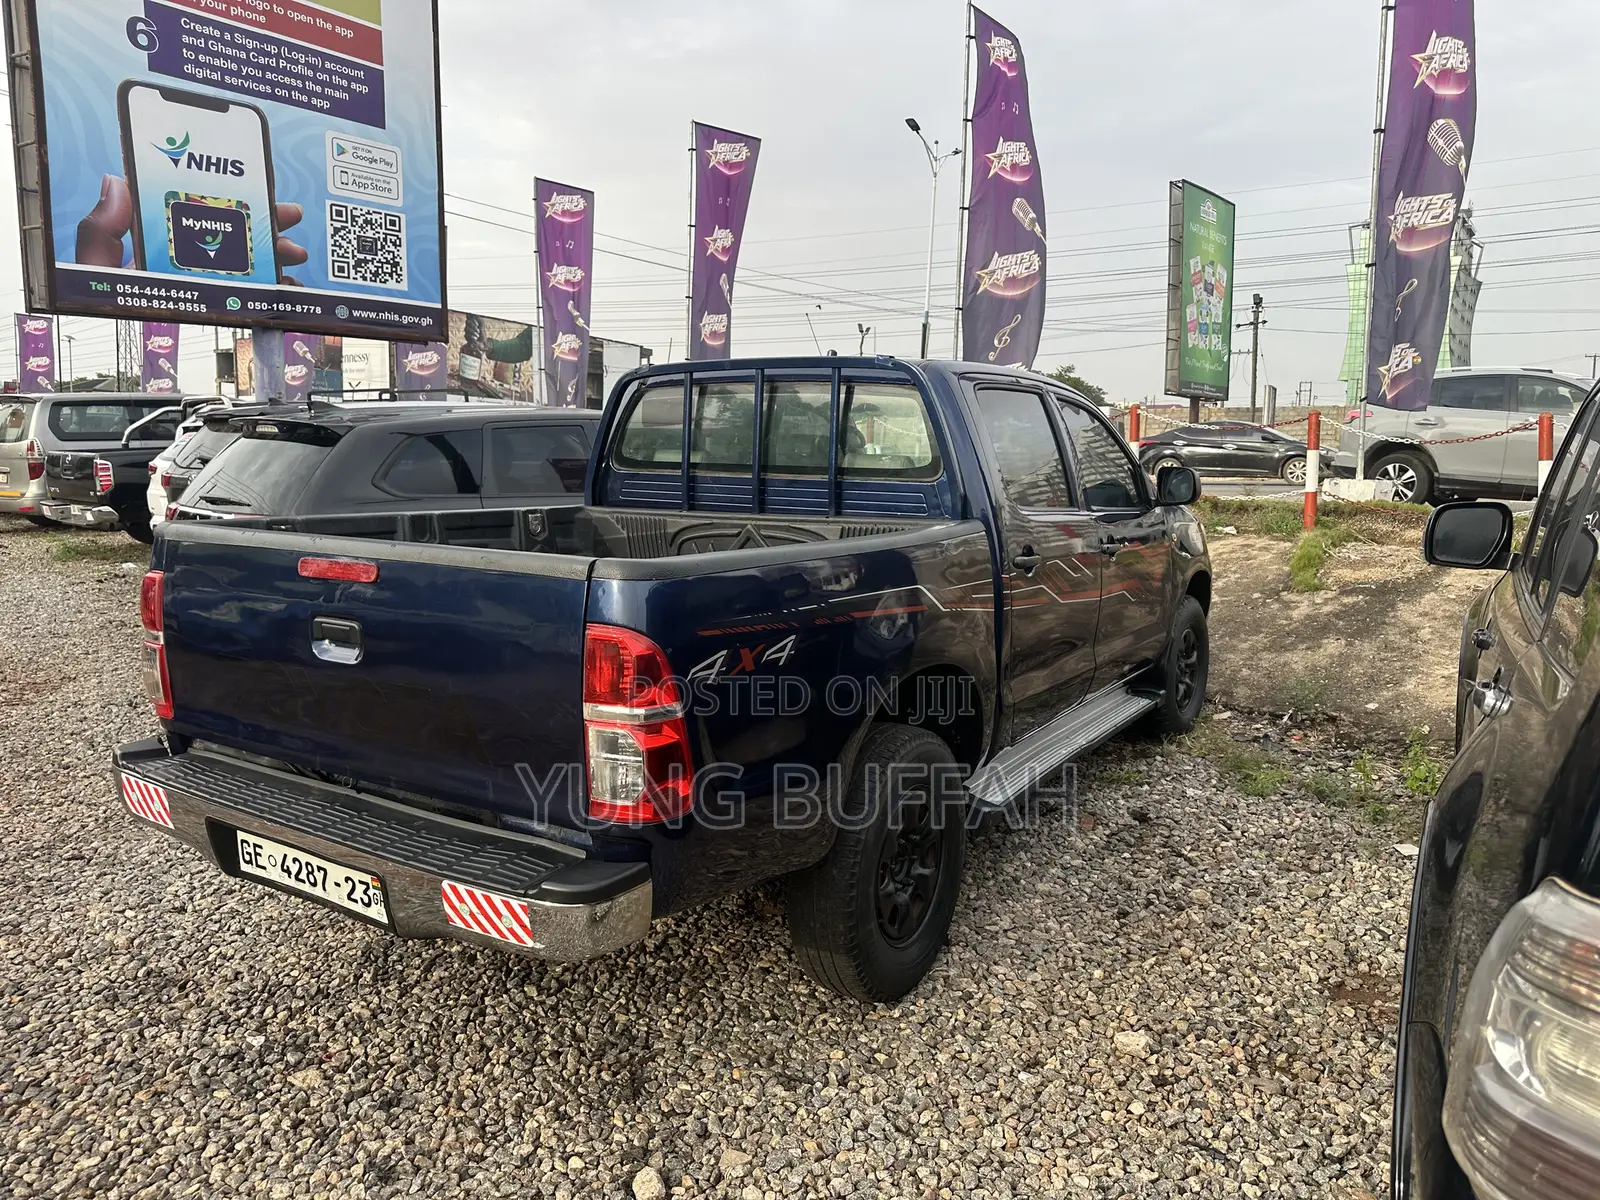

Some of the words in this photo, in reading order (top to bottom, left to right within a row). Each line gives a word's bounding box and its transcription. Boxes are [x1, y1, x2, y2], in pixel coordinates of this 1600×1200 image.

[200, 0, 227, 11] your
[230, 6, 266, 23] phone
[273, 4, 284, 15] to
[288, 10, 313, 25] open
[316, 16, 332, 31] the
[335, 24, 354, 39] app
[126, 15, 158, 53] 6
[180, 17, 222, 38] Create
[224, 31, 231, 40] a
[234, 32, 278, 55] Sign-up
[281, 45, 322, 68] (Log-in)
[325, 59, 365, 79] account
[181, 33, 205, 48] and
[208, 40, 246, 60] Ghana
[250, 51, 276, 67] Card
[280, 59, 313, 78] Profile
[316, 71, 330, 82] on
[332, 73, 348, 87] the
[350, 80, 369, 94] app
[182, 48, 196, 59] to
[198, 51, 238, 72] enable
[240, 64, 262, 78] you
[265, 70, 303, 88] access
[305, 79, 322, 94] the
[325, 85, 349, 101] main
[183, 63, 221, 81] digital
[224, 75, 272, 93] services
[275, 87, 289, 98] on
[291, 89, 308, 103] the
[311, 96, 330, 110] app
[186, 151, 245, 177] NHIS
[352, 151, 378, 164] Google
[379, 157, 393, 169] Play
[351, 172, 374, 182] Available
[351, 178, 369, 190] App
[370, 182, 392, 194] Store
[181, 216, 233, 232] MyNHIS
[988, 249, 1035, 270] LIGHTS
[89, 281, 111, 292] Tel:
[116, 283, 199, 300] 054-444-6447
[117, 296, 207, 313] 0308-824-9555
[247, 301, 322, 315] 050-169-8778
[352, 309, 433, 327] www.nhis.gov.gh
[240, 838, 267, 871] GE
